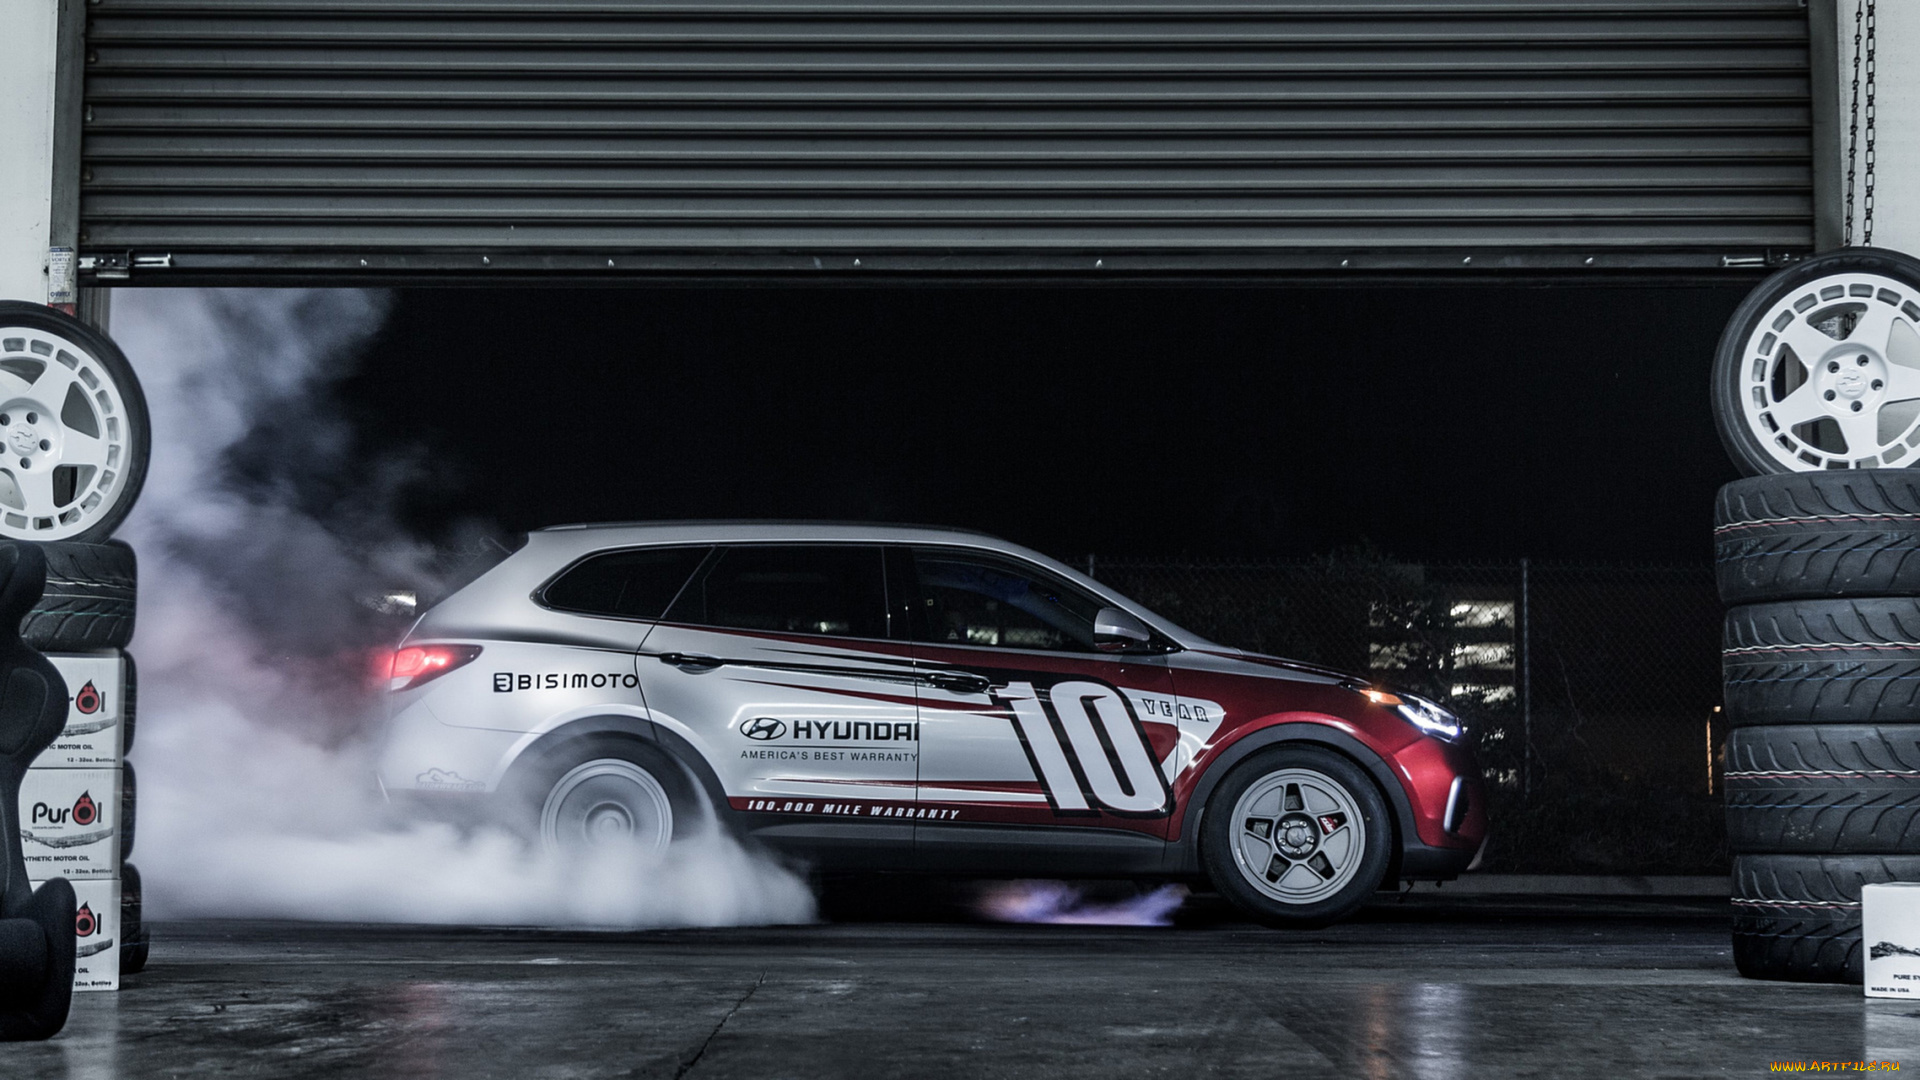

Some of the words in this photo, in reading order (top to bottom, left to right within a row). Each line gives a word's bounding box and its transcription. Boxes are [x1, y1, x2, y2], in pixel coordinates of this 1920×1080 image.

[518, 673, 638, 690] BISIMOTO
[793, 720, 919, 741] HYUNDAI
[994, 680, 1168, 812] 10
[1142, 698, 1210, 722] YEAR
[741, 750, 808, 760] AMERICA'S
[814, 752, 845, 761] BEST
[850, 752, 918, 762] WARRANTY
[822, 804, 862, 815] MILE
[870, 807, 960, 820] WARRANTY
